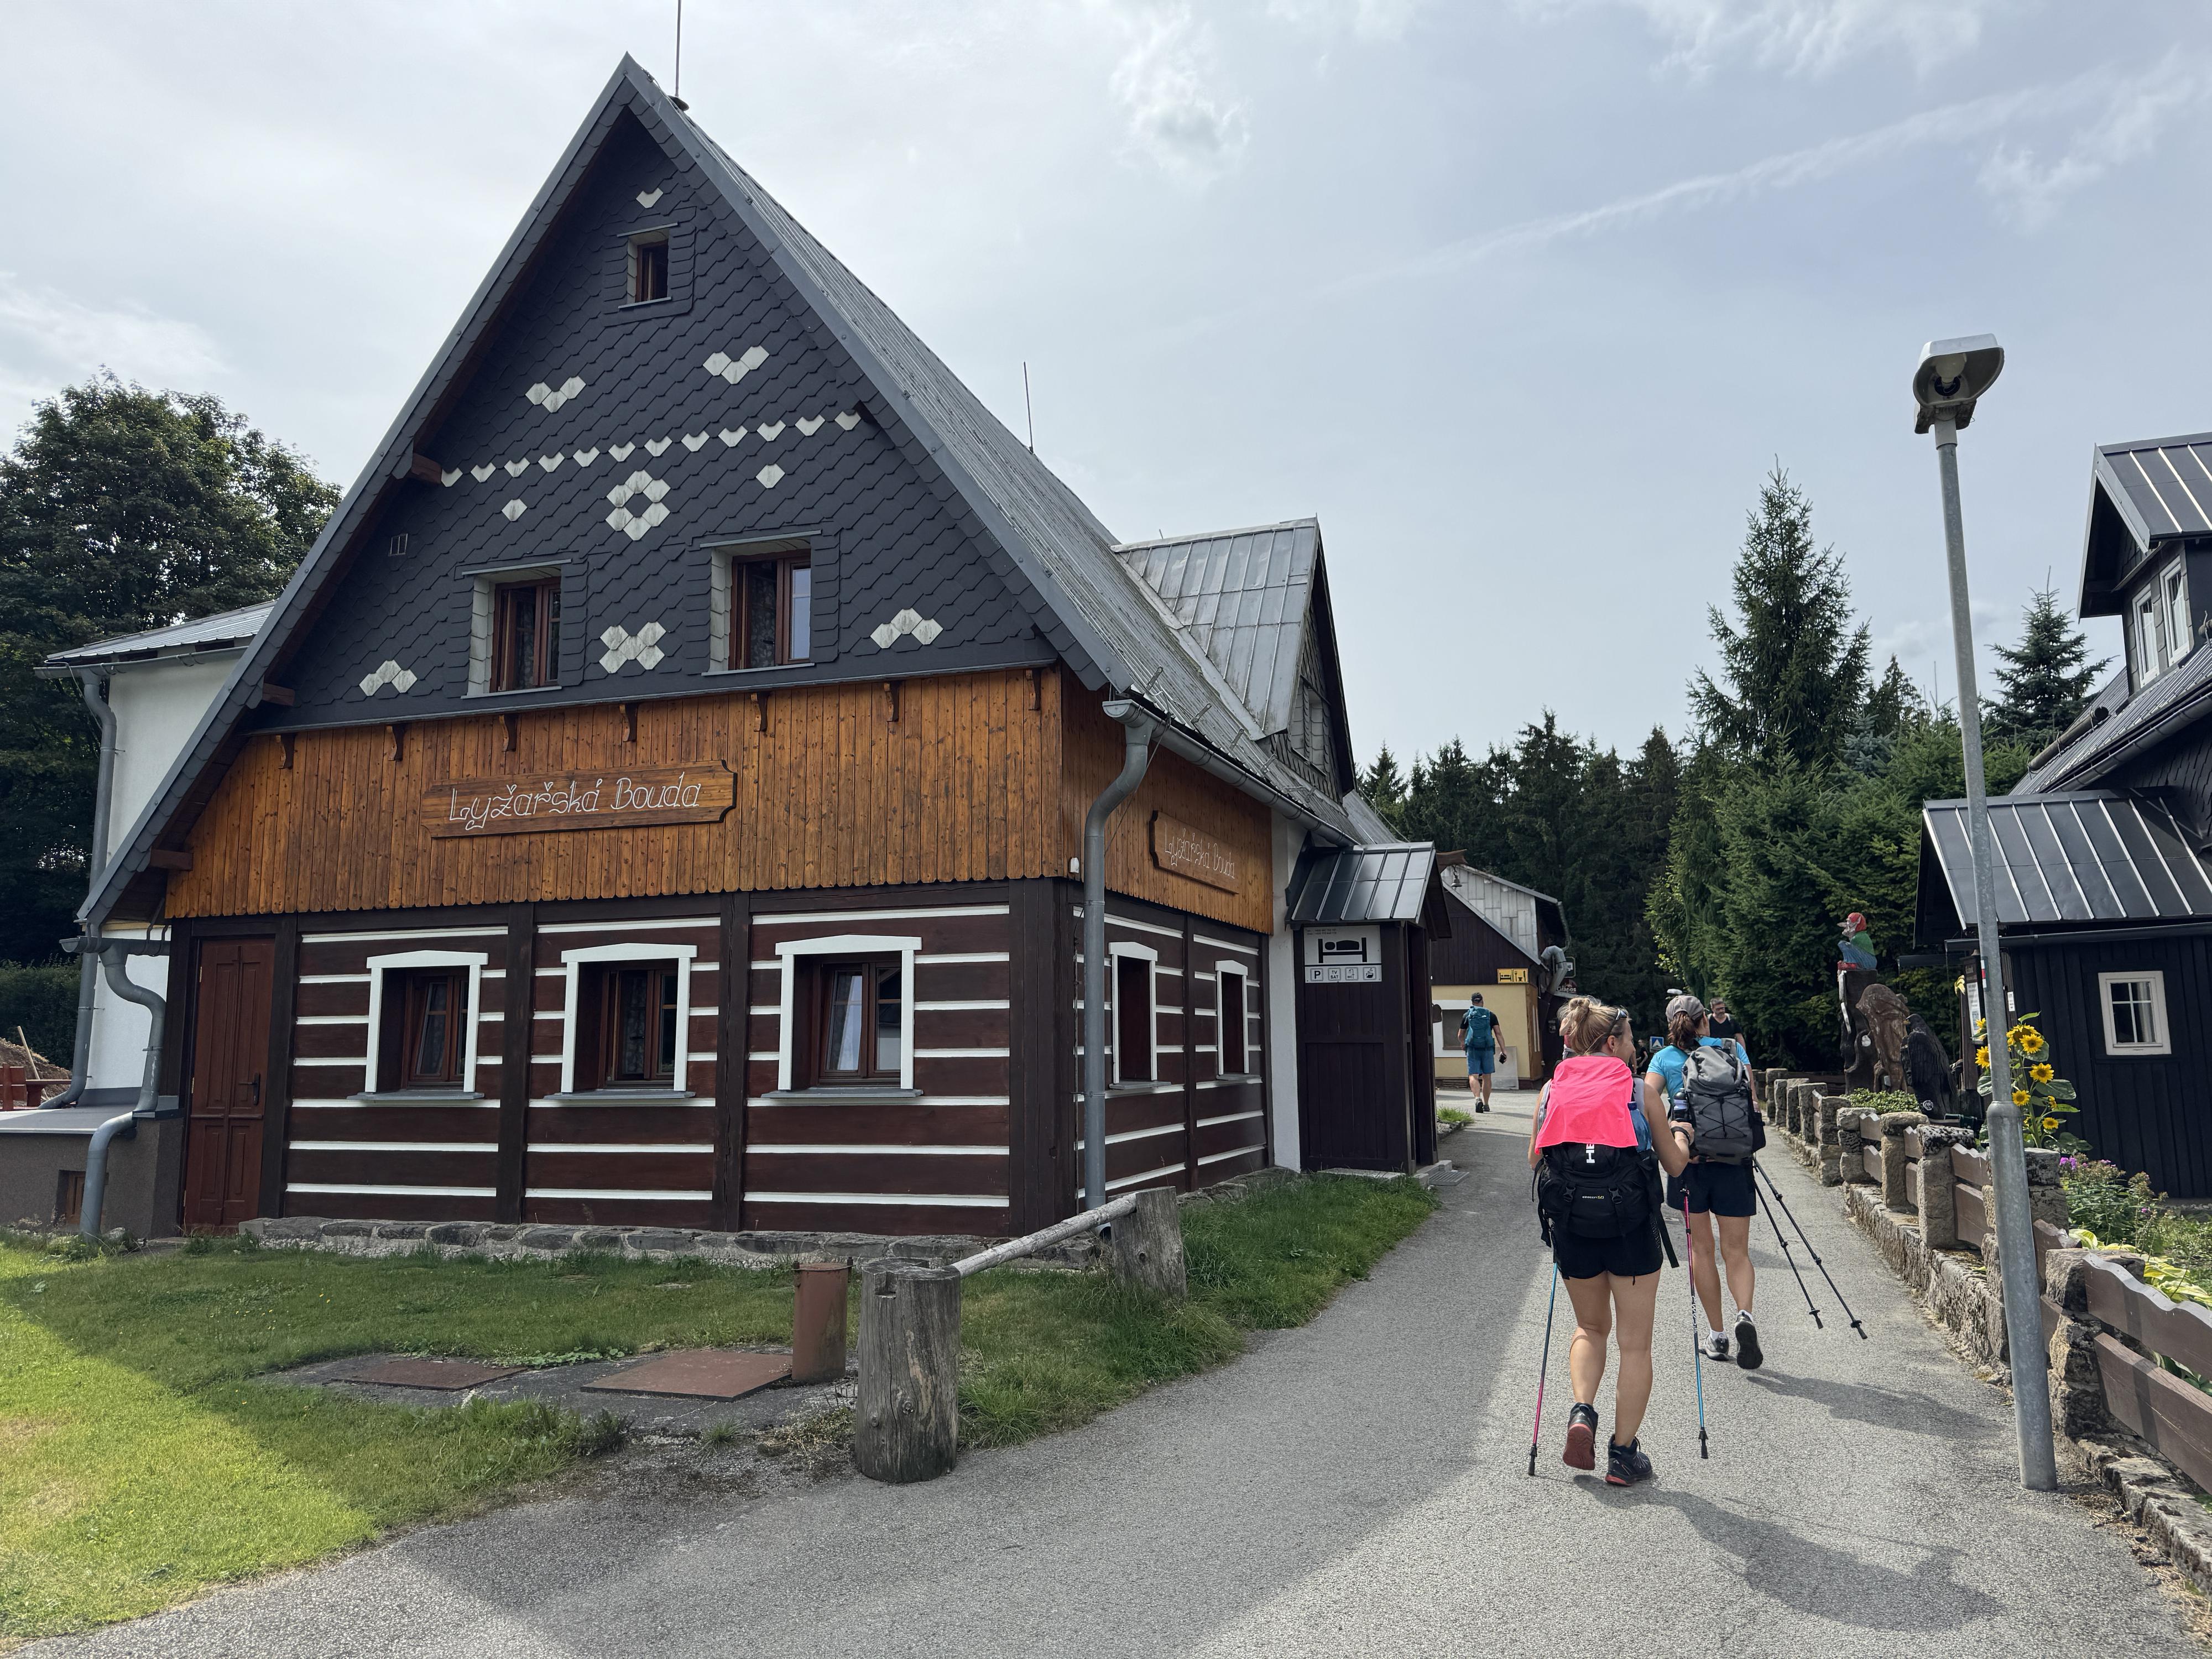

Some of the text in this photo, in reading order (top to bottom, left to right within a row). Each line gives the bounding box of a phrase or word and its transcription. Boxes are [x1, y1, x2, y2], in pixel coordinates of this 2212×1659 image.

[448, 771, 702, 831] Lyžařská Bouda
[1314, 971, 1321, 979] P
